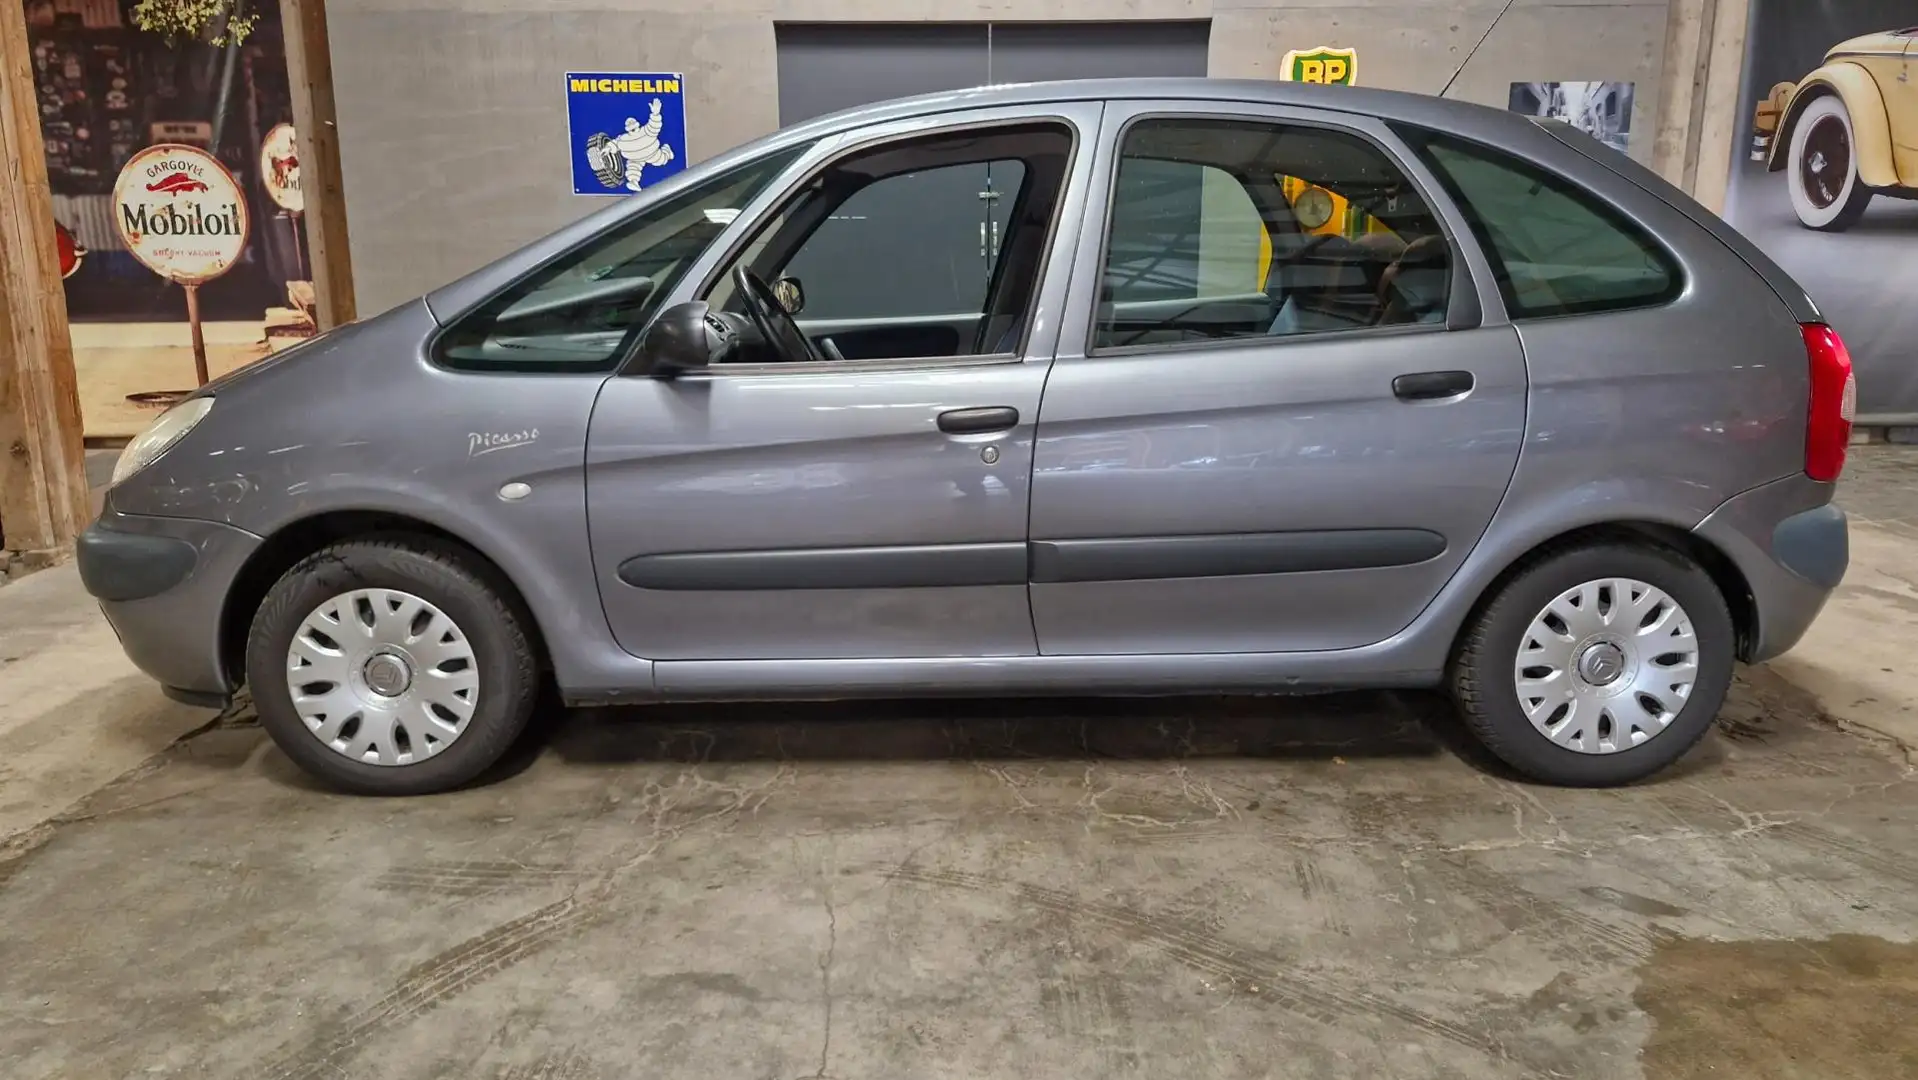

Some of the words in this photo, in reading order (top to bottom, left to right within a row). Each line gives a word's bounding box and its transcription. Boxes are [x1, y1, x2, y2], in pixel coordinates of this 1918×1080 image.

[570, 79, 680, 93] MICHELIN
[146, 160, 205, 178] GARGOYLE
[121, 202, 241, 236] Mobiloil
[465, 428, 540, 459] Picasso
